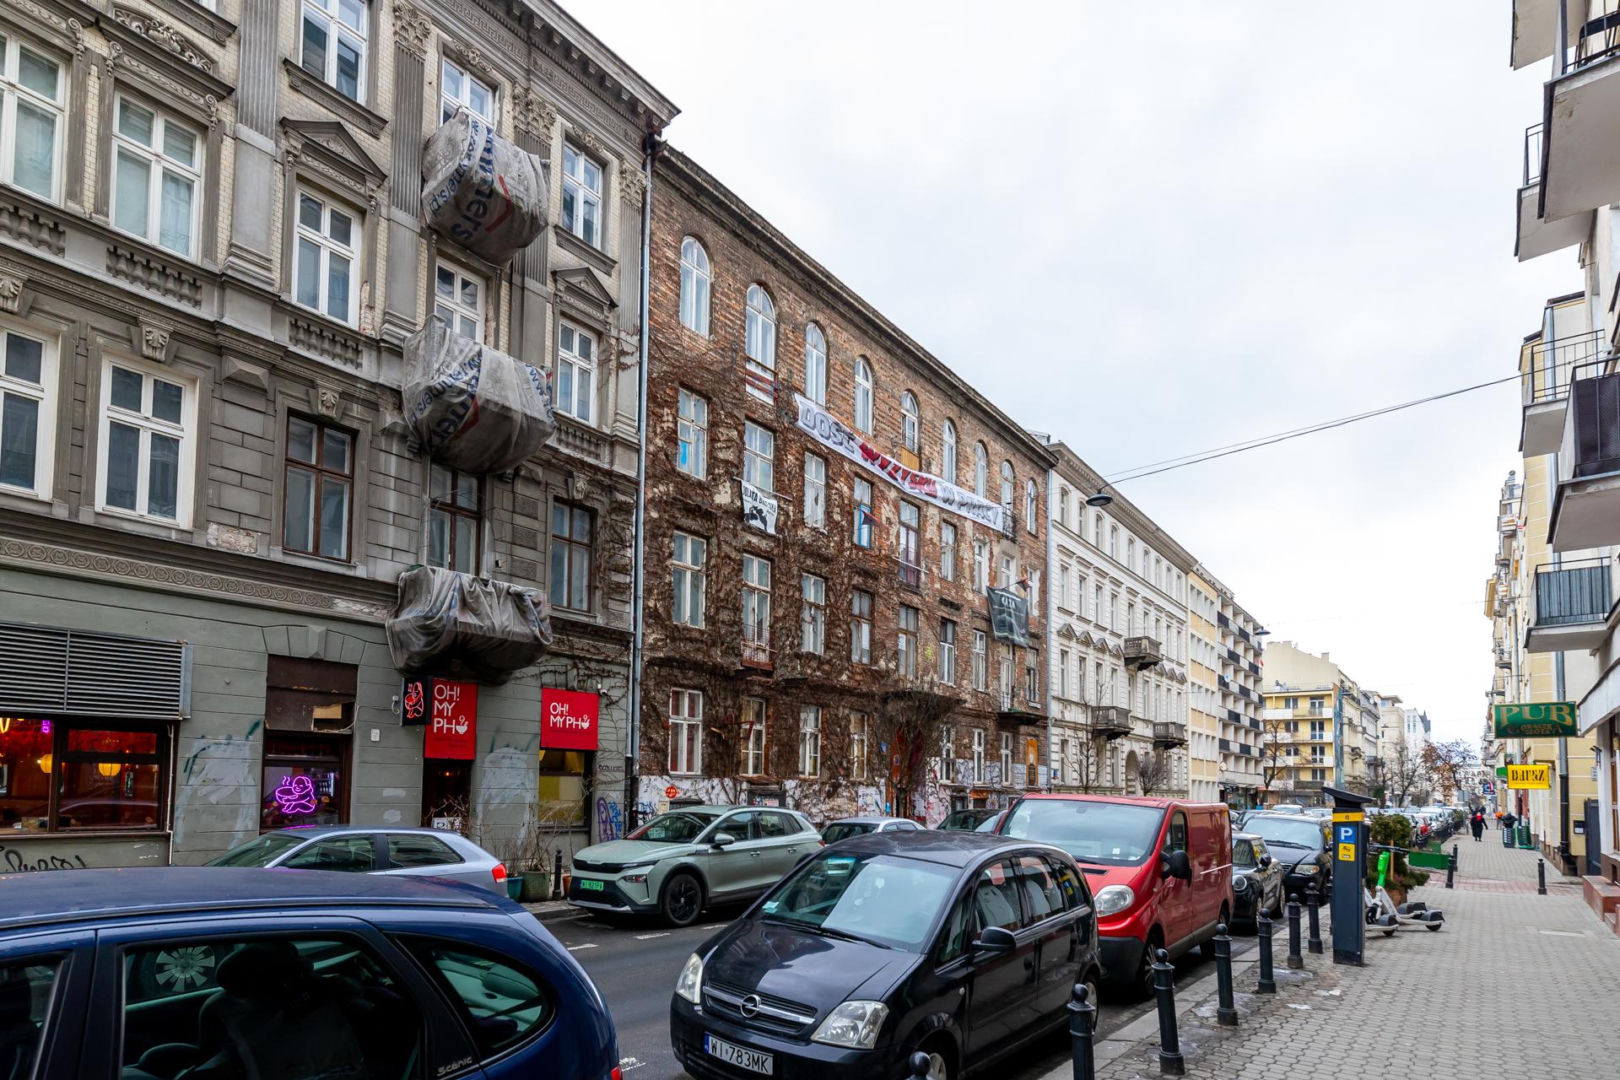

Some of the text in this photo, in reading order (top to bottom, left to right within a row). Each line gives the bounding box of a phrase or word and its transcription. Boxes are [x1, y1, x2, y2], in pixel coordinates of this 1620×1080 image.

[434, 684, 460, 701] OH!
[433, 700, 456, 717] MY
[550, 702, 569, 716] OH!
[1498, 705, 1573, 728] PUB
[550, 715, 565, 728] MY
[1340, 827, 1353, 841] P
[710, 1038, 769, 1074] WI 783MK
